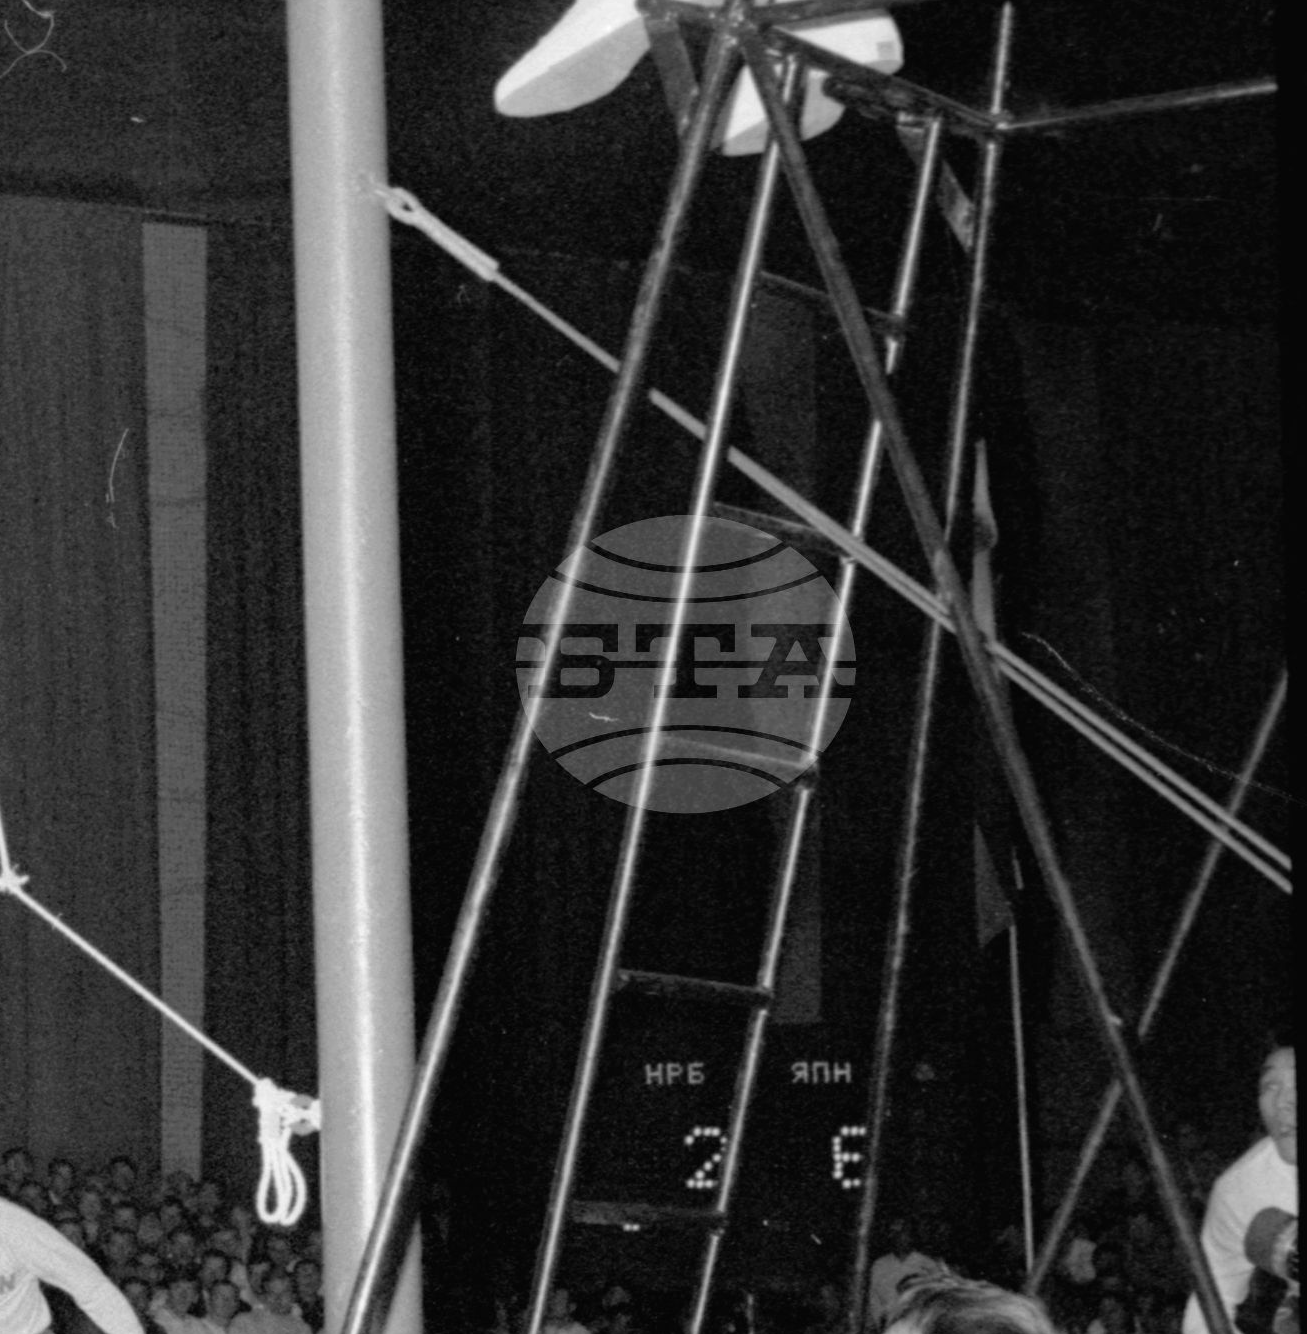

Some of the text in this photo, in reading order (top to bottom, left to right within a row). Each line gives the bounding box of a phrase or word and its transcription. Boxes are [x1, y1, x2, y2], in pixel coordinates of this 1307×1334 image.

[645, 1061, 706, 1086] НРБ
[791, 1061, 853, 1085] ЯПН
[684, 1125, 728, 1190] 2
